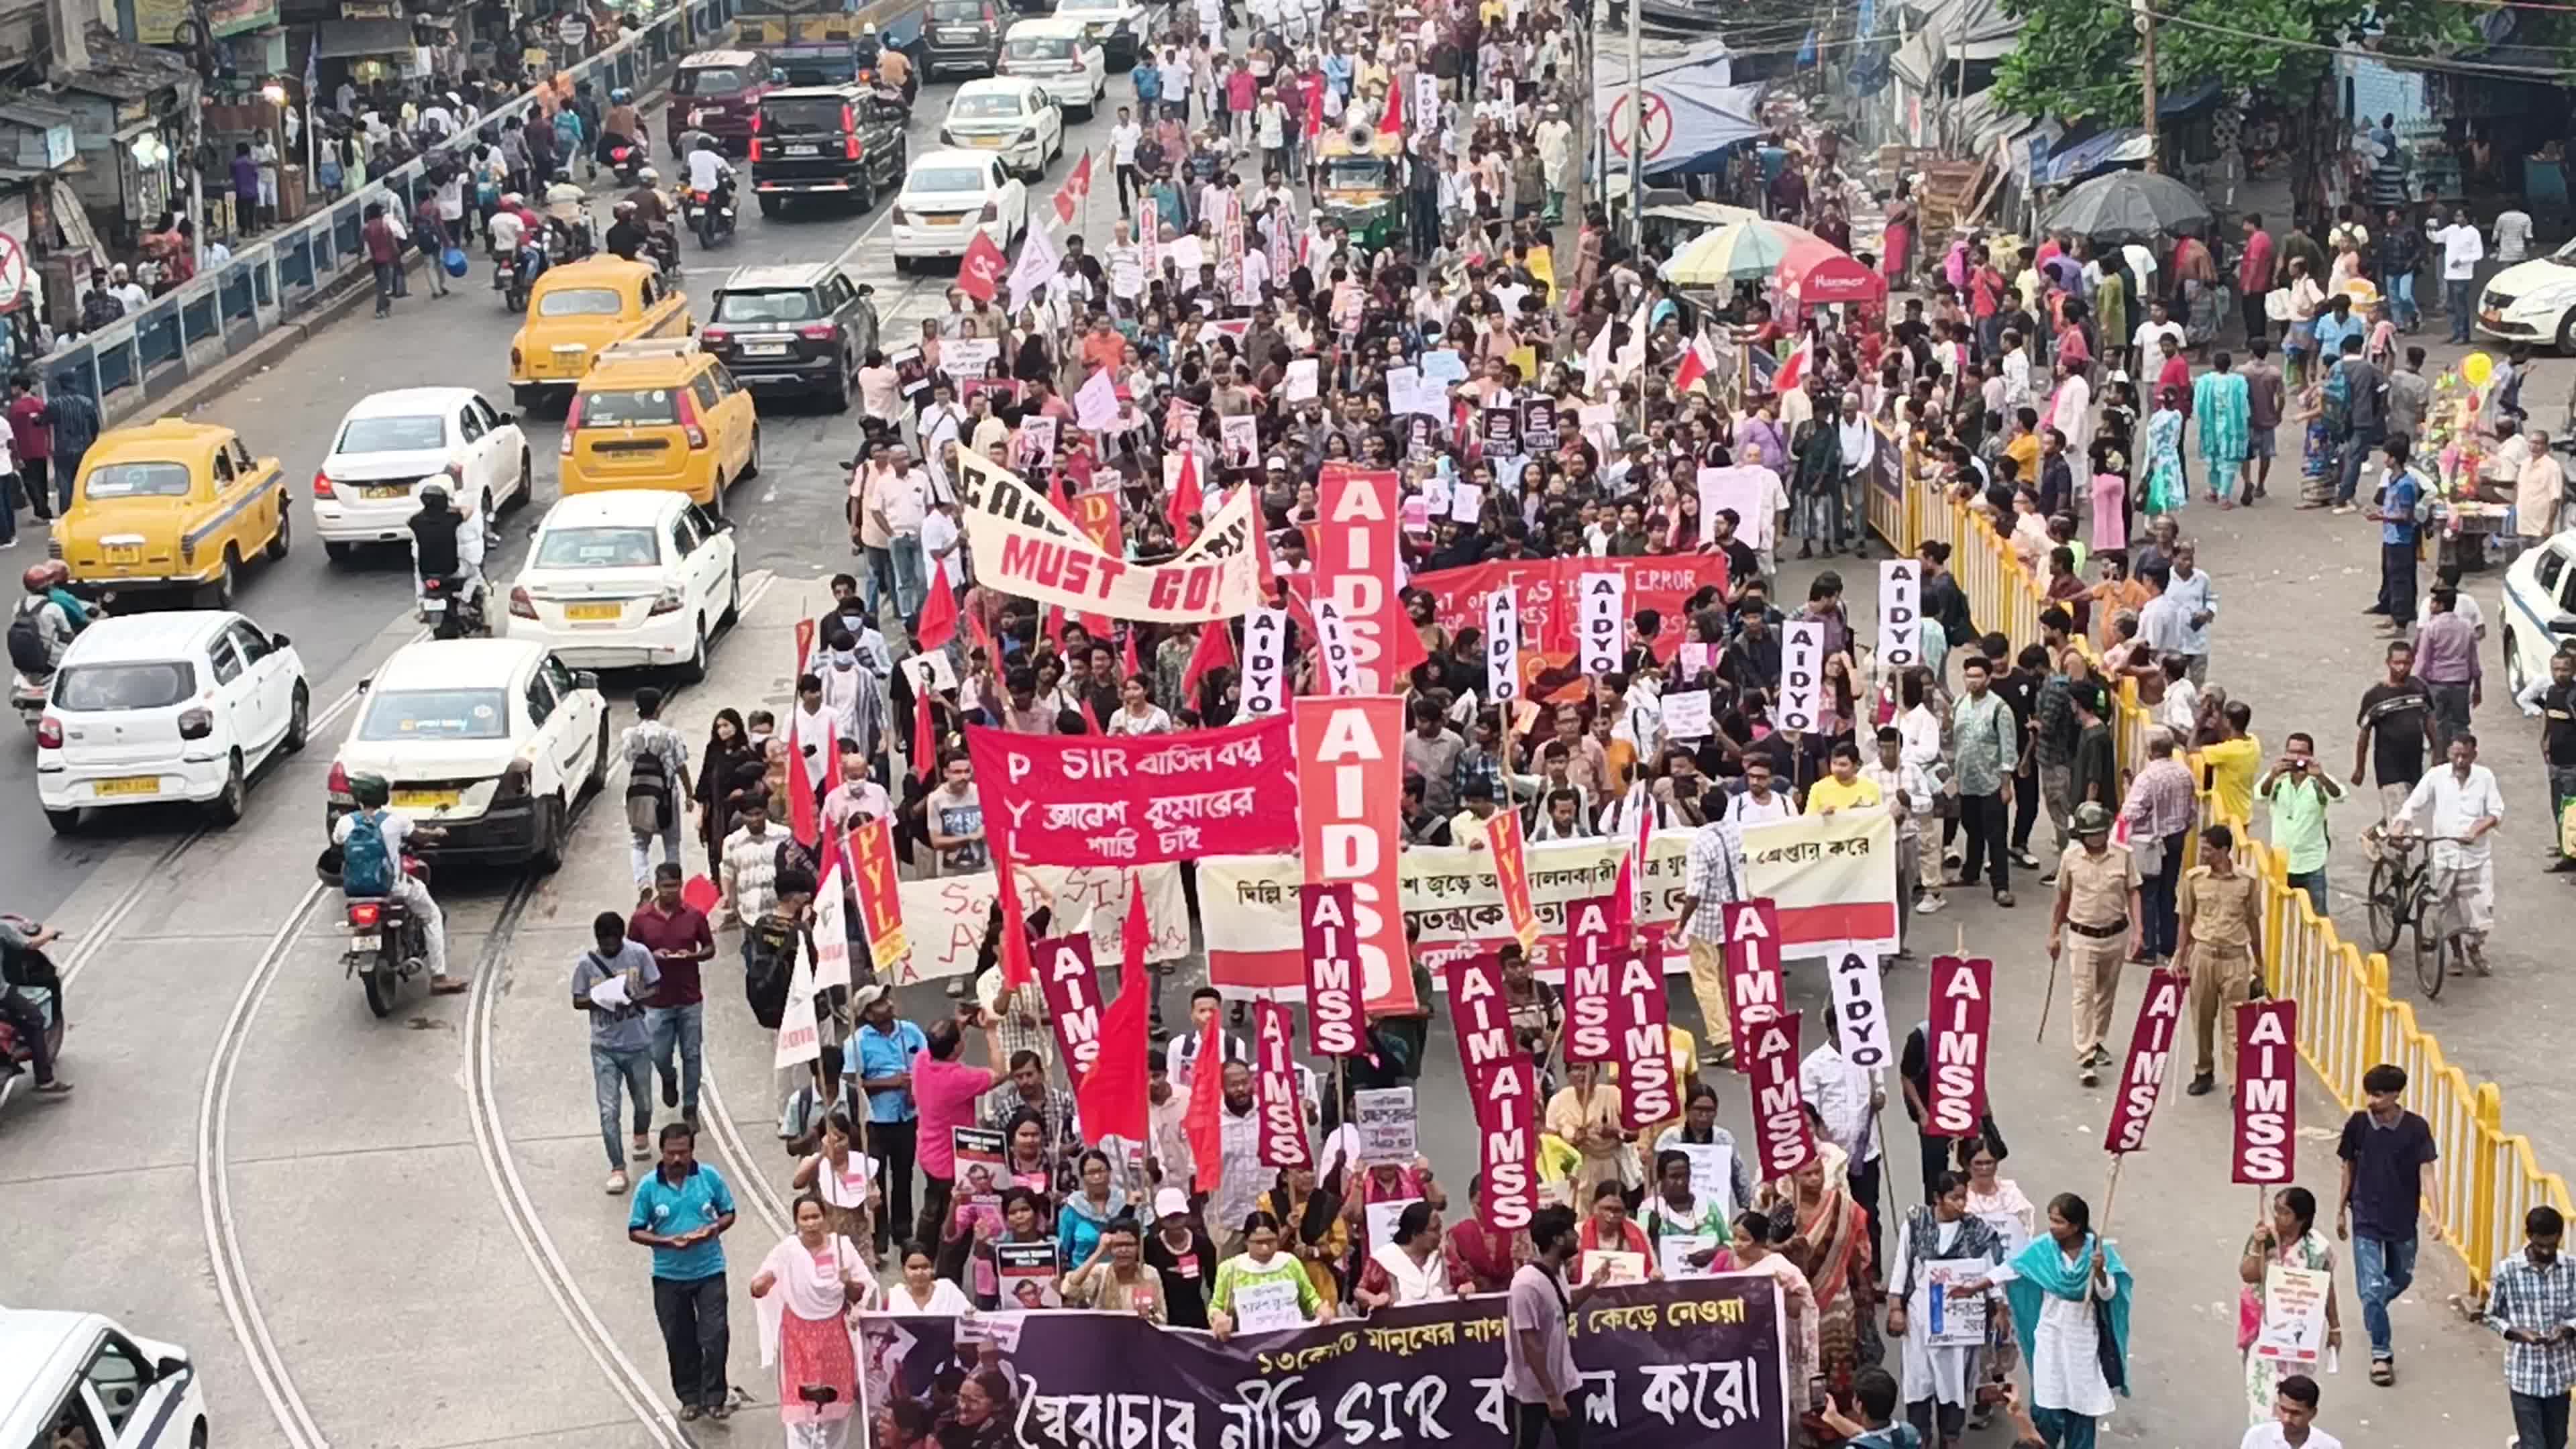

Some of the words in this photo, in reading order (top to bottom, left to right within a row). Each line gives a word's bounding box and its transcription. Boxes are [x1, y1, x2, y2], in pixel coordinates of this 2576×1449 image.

[1001, 534, 1125, 599] MUST
[1148, 565, 1225, 614] GO!
[1590, 580, 1615, 672] AIDYO
[1613, 563, 1696, 595] TERROR
[1888, 566, 1913, 665] AIDYO
[1248, 614, 1276, 712] AIDYO
[1494, 594, 1513, 699] AIDYO
[1786, 629, 1812, 729] AIDYO
[1061, 748, 1128, 780] SIR
[858, 828, 894, 931] PYL
[1495, 814, 1528, 932] PYL
[1828, 836, 1869, 855] করে
[1053, 947, 1100, 1073] AIMS
[1312, 895, 1356, 1052] AIMSS
[1460, 967, 1507, 1067] AIM
[1574, 904, 1611, 1057] AIMSS
[1840, 953, 1883, 1067] AIDYO
[1263, 1009, 1305, 1164] AIMSS
[1620, 959, 1671, 1123] AIMSS
[1937, 967, 1981, 1132] AIMSS
[2121, 985, 2176, 1150] AIMSS
[1487, 1066, 1532, 1229] AIMSS
[1758, 1027, 1806, 1171] AIMSS
[2242, 1011, 2287, 1181] AIMSS
[1334, 1375, 1452, 1446] SIR
